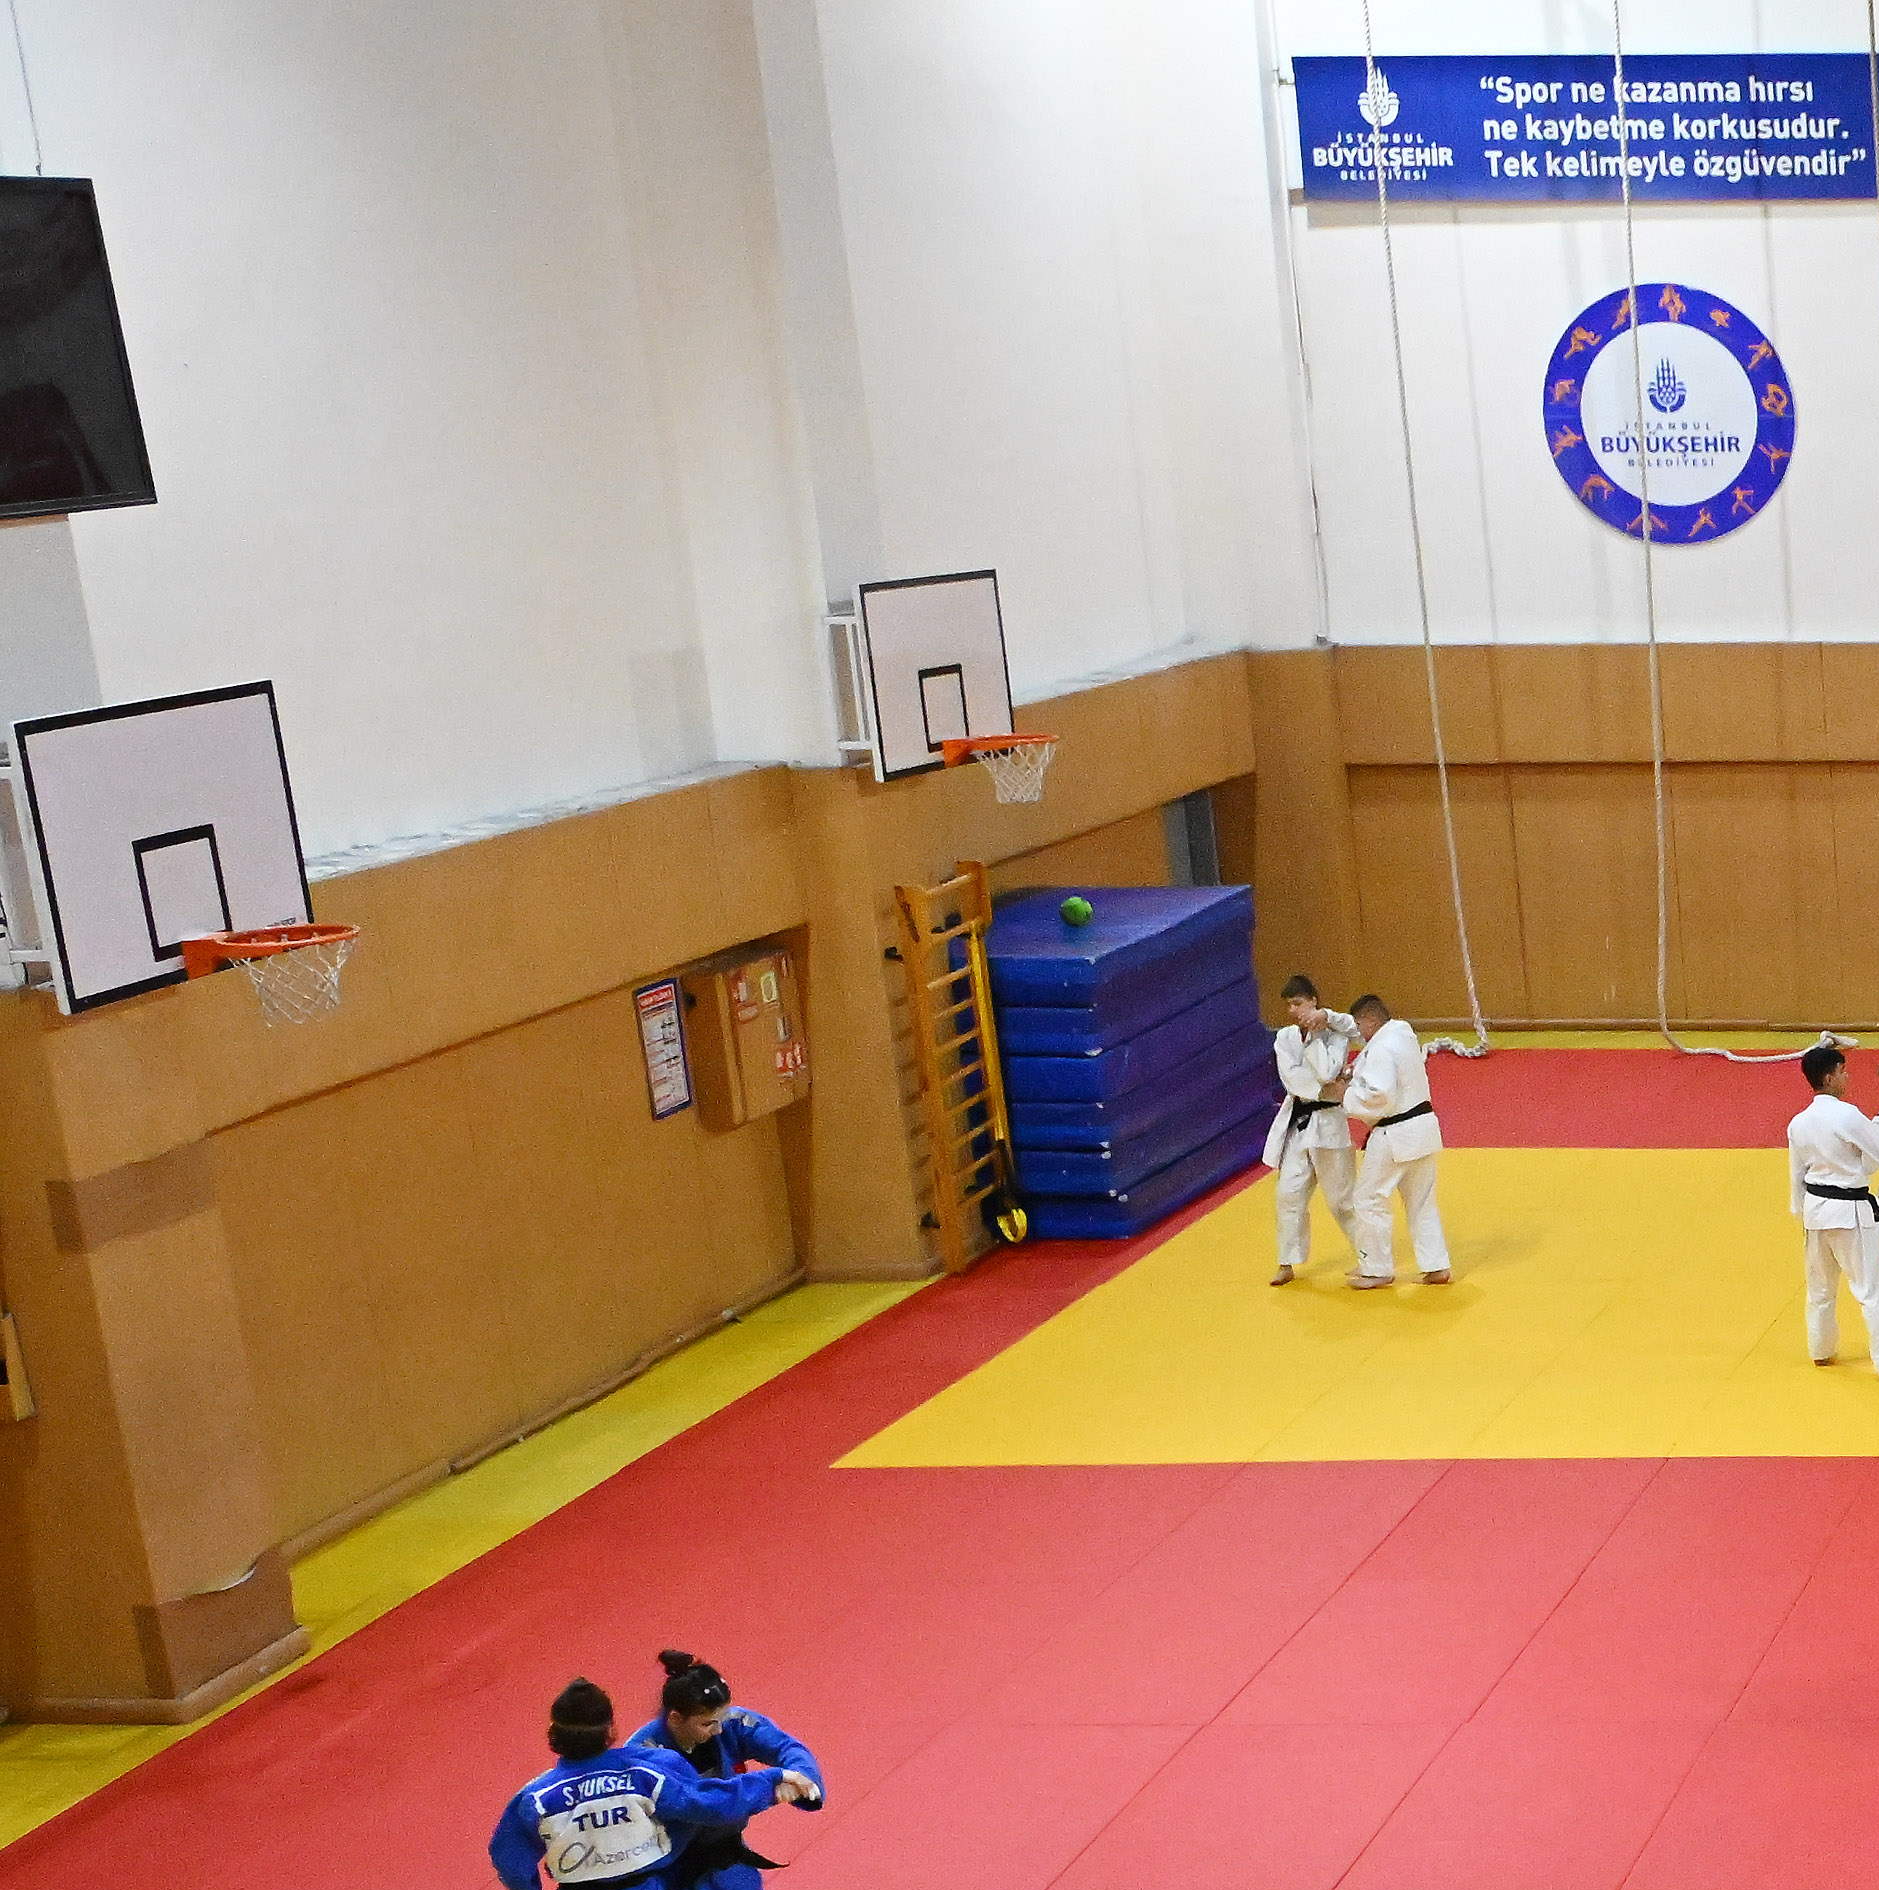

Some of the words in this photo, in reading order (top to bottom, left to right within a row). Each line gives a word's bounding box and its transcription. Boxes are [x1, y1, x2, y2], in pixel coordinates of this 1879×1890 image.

[1480, 76, 1564, 109] “Spor
[1570, 82, 1605, 103] ne
[1613, 75, 1741, 103] kazanma
[1748, 74, 1814, 102] hırsı
[1483, 119, 1518, 140] ne
[1525, 112, 1666, 146] kaybetme
[1673, 112, 1849, 140] korkusudur.
[1313, 141, 1454, 171] BÜYÜKŞEHİR
[1484, 150, 1539, 177] Tek
[1545, 150, 1686, 183] kelimeyle
[1693, 148, 1867, 184] özgüvendir”
[1340, 168, 1427, 181] BELEİYESİ
[1601, 431, 1741, 458] BÜYÜKŞEHİR
[1627, 457, 1715, 468] BLEDİYESİ
[572, 1806, 632, 1833] TUR
